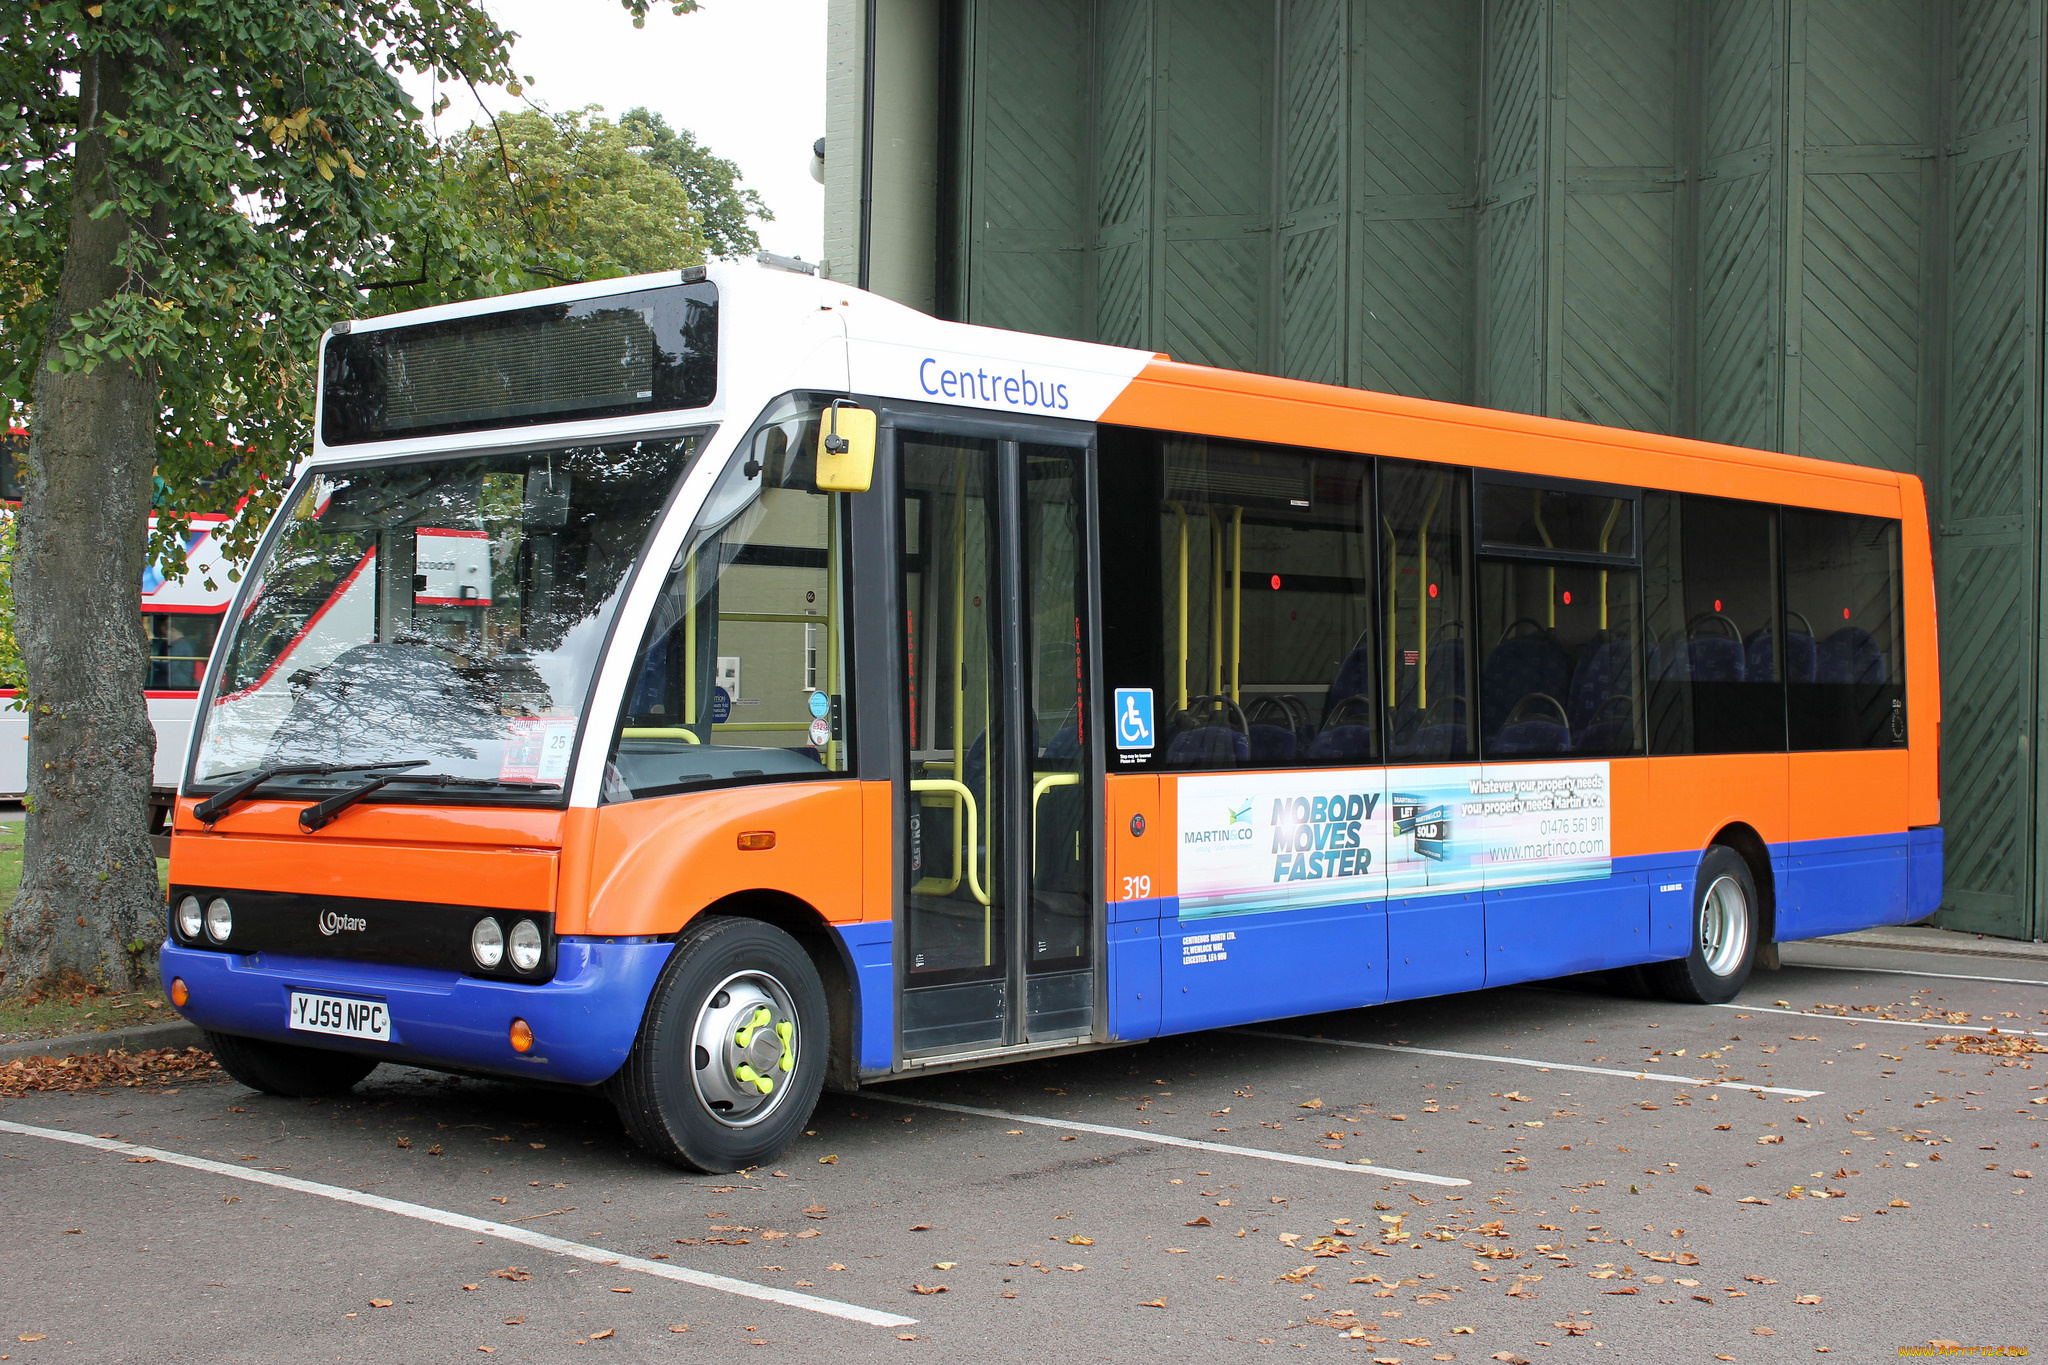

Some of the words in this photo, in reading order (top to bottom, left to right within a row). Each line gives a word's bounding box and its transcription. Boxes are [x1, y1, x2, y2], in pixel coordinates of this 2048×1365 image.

[920, 358, 1069, 410] Centrebus
[417, 561, 456, 571] ecoach
[551, 735, 567, 749] 25
[1469, 779, 1514, 794] Whatever
[1515, 780, 1537, 794] your
[1537, 776, 1576, 792] property
[1576, 775, 1604, 790] needs,
[1270, 793, 1380, 826] NOBODY
[1400, 807, 1413, 819] LET
[1461, 802, 1483, 817] your
[1484, 798, 1525, 816] property
[1526, 796, 1553, 811] needs
[1554, 794, 1582, 809] Martin
[1583, 796, 1589, 807] &
[1591, 793, 1604, 807] Co.
[1271, 820, 1362, 854] MOVES
[1417, 824, 1438, 838] SOLD
[1540, 818, 1569, 835] 01476
[1572, 817, 1588, 832] 561
[1590, 816, 1604, 831] 911
[1489, 838, 1604, 861] www.martinco.com
[1273, 847, 1372, 883] FASTER
[1122, 875, 1151, 900] 319
[327, 911, 367, 934] Optare
[1182, 935, 1210, 945] CENTREBUS
[1210, 932, 1226, 942] NORTH
[298, 997, 343, 1029] YJ59
[346, 1003, 383, 1034] NPC
